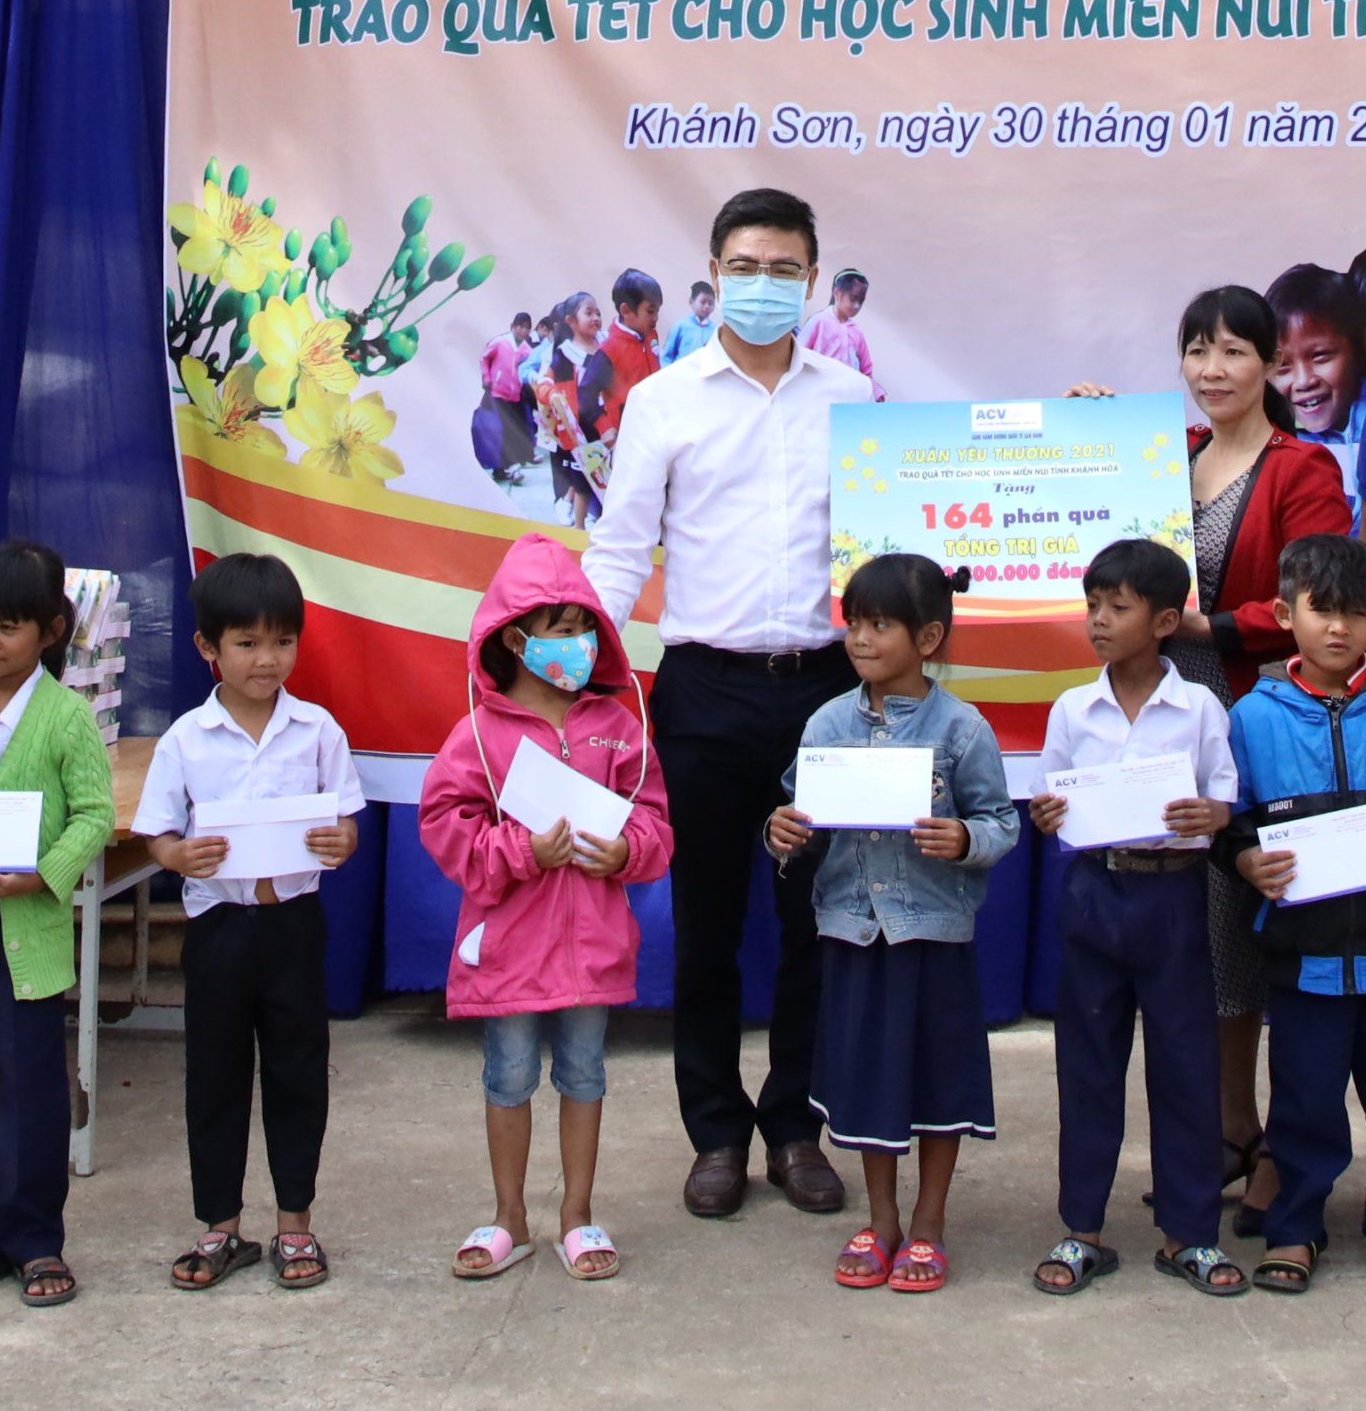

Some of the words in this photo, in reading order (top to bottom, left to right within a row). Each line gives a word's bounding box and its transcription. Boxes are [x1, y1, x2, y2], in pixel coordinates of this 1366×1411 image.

[624, 102, 759, 149] Khánh
[769, 103, 866, 153] Sơn,
[875, 104, 985, 158] ngày
[989, 103, 1046, 147] 30
[1053, 102, 1174, 157] tháng
[1181, 102, 1235, 147] 01
[1244, 102, 1337, 147] năm
[976, 409, 1006, 420] ACV
[901, 446, 950, 463] XUÂN
[957, 445, 987, 462] YÊU
[1070, 443, 1115, 459] 2021
[922, 502, 993, 530] 164
[1068, 505, 1110, 525] quà
[944, 533, 1001, 557] TỔNG
[1006, 538, 1036, 559] TRỊ
[1043, 533, 1080, 554] GIÁ
[804, 754, 826, 763] ACV
[1055, 777, 1078, 788] ACV
[1267, 829, 1290, 842] ACV
